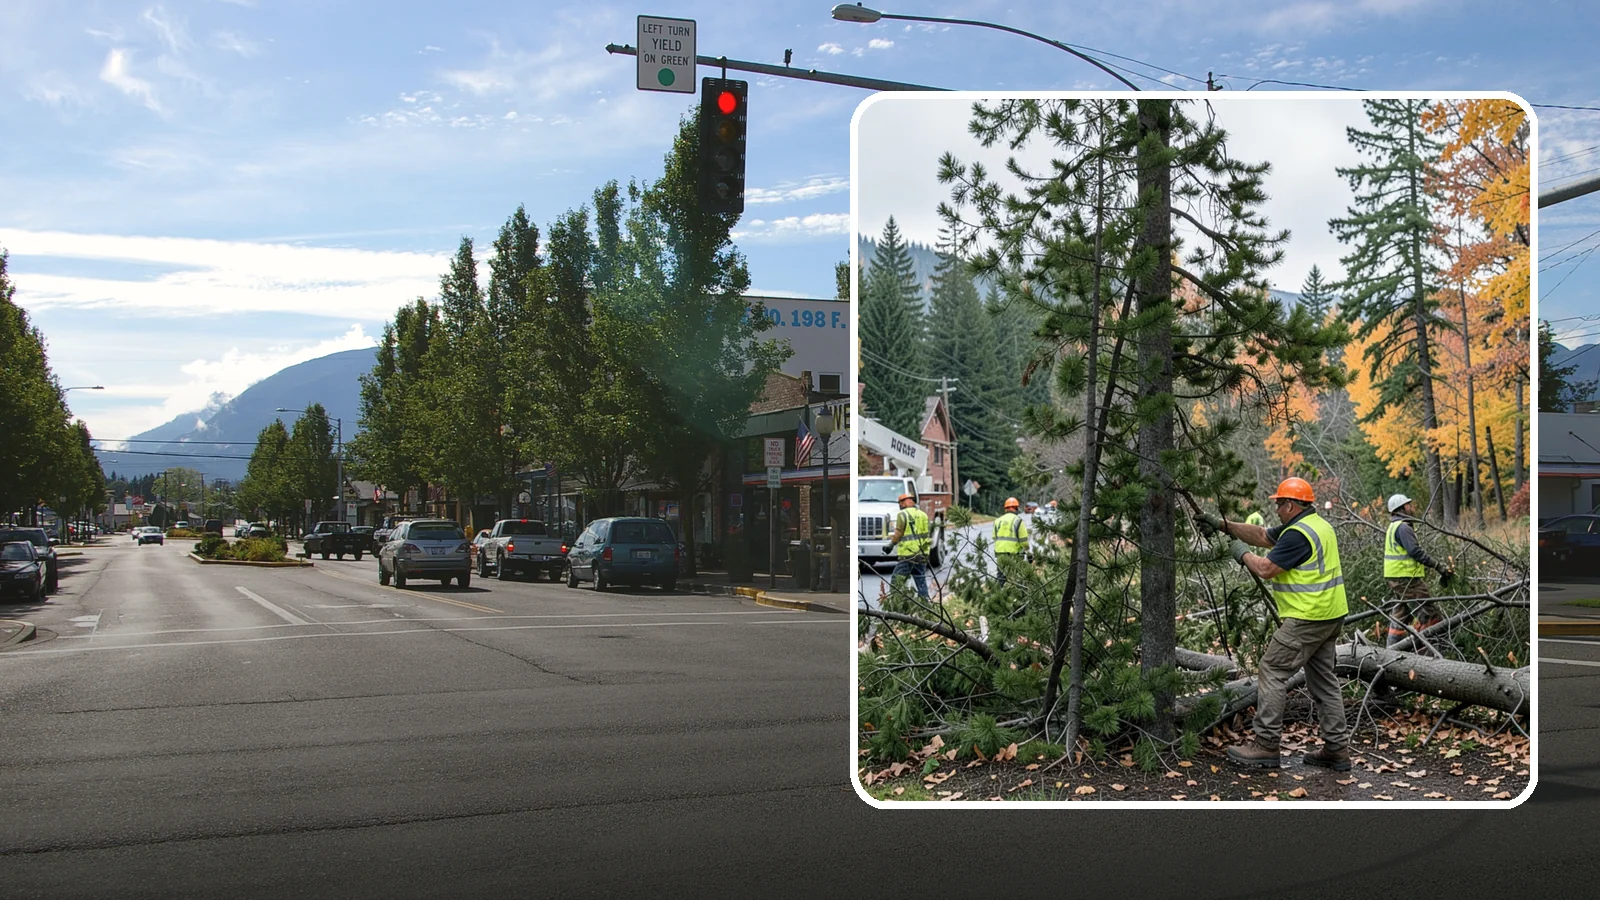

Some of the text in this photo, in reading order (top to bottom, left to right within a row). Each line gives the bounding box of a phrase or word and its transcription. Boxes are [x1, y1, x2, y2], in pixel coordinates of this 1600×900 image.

[643, 24, 690, 36] LEFT TURN
[652, 38, 682, 52] YIELD
[644, 53, 689, 66] ON GREEN
[791, 309, 826, 328] 198
[831, 311, 846, 329] F.
